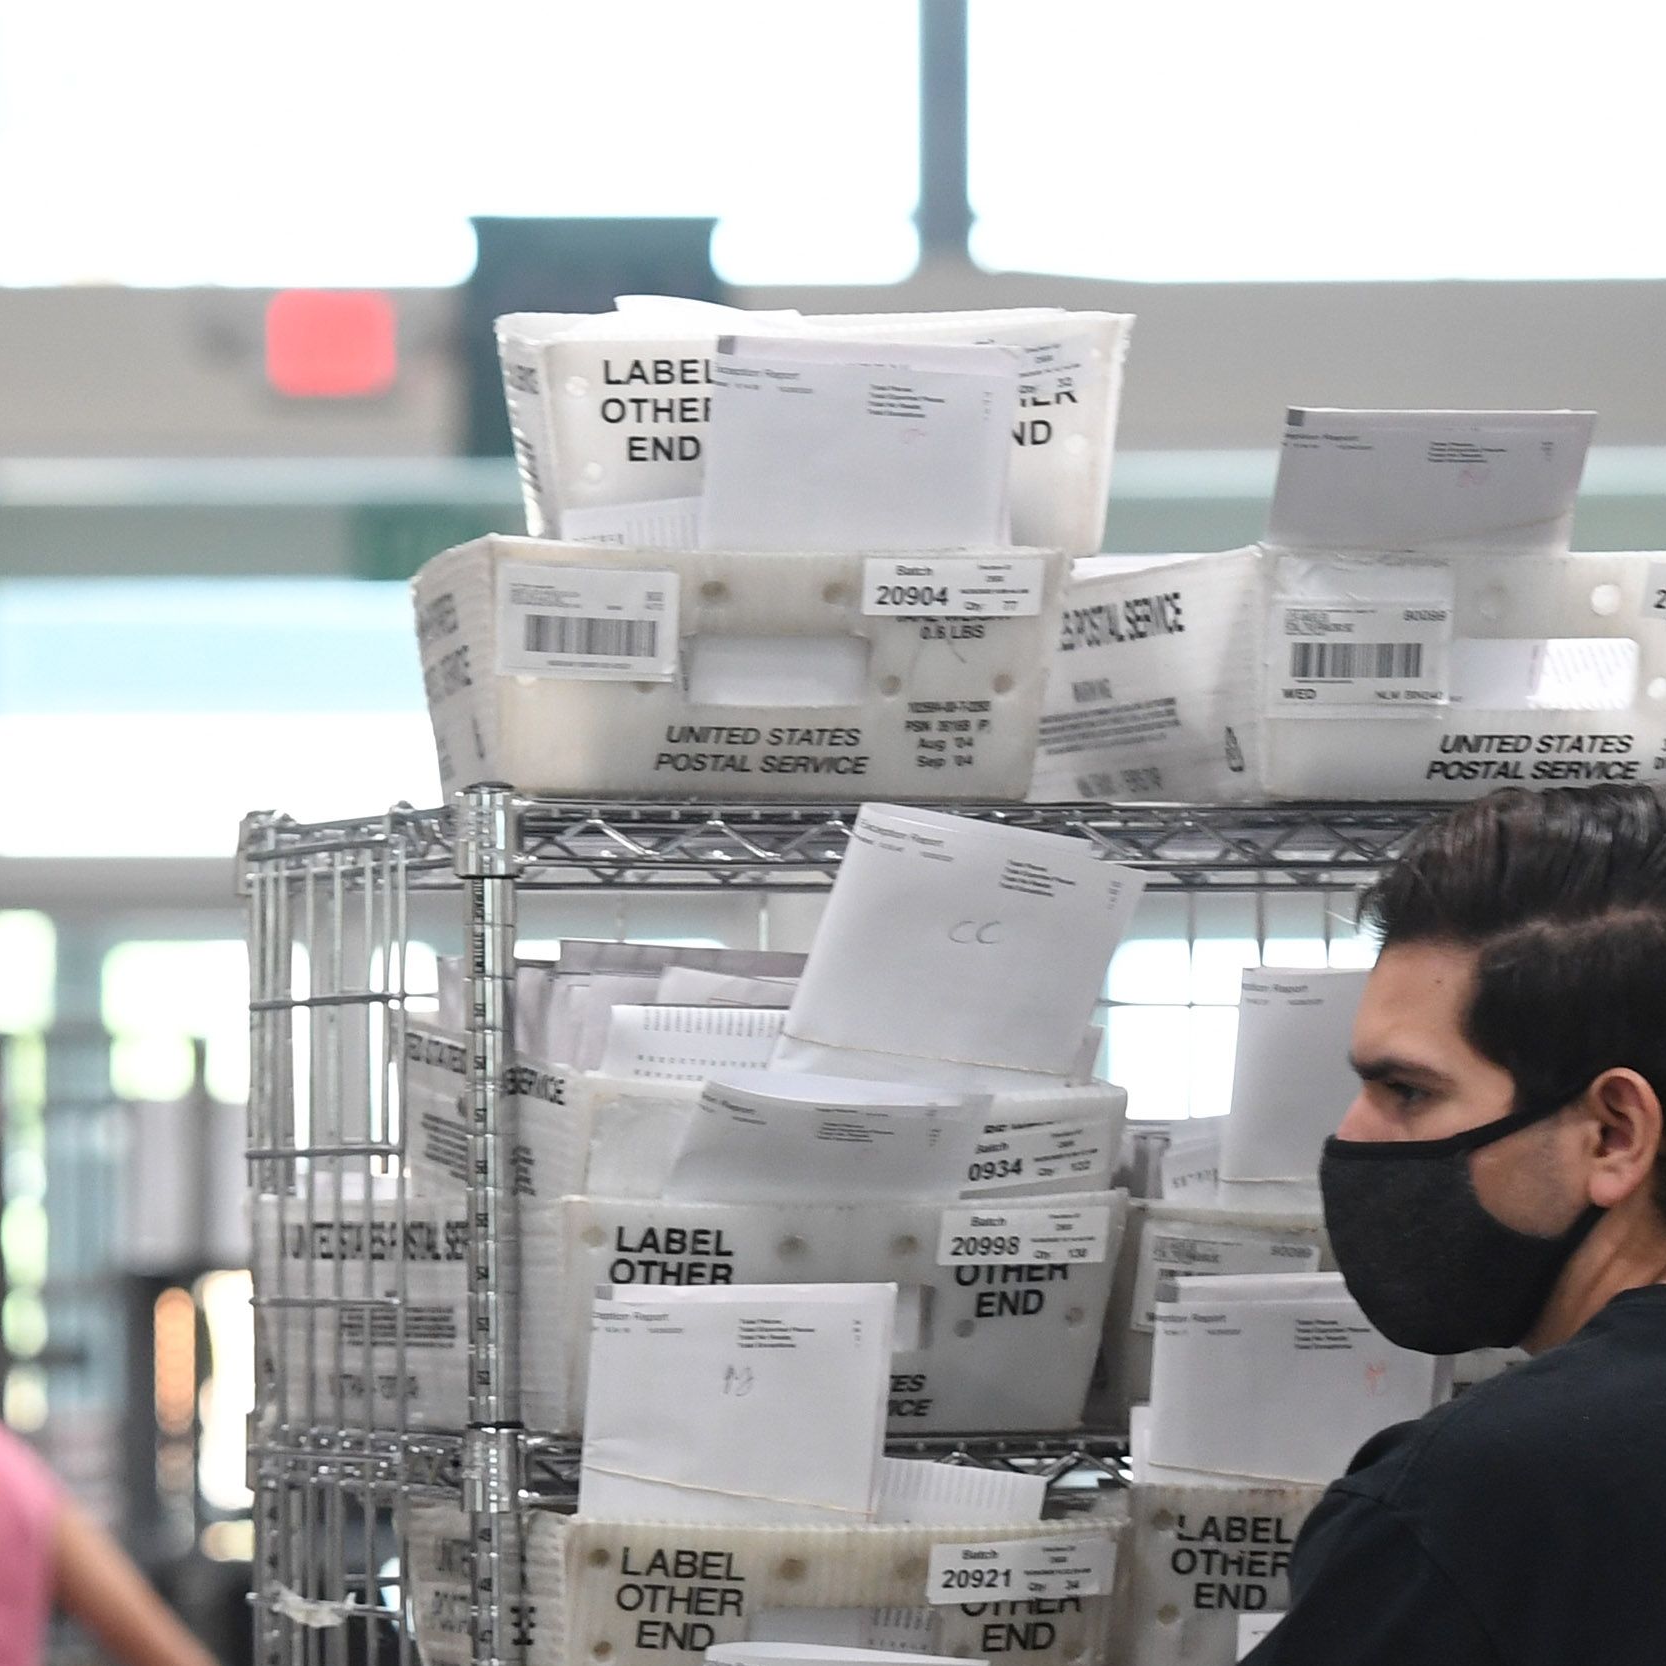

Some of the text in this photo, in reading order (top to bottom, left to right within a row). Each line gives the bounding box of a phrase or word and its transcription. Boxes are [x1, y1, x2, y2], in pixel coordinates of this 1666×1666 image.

[627, 434, 702, 462] END
[895, 564, 933, 576] Batch
[875, 585, 950, 606] 20904
[950, 624, 985, 640] LBS
[1281, 688, 1317, 701] WED
[665, 725, 861, 747] UNITED STATES
[1439, 733, 1634, 754] UNITED STATES
[654, 752, 870, 775] POSTAL SERVICE
[1425, 760, 1640, 781] POSTAL SERVICE
[967, 1157, 1023, 1182] 0934
[969, 1215, 1007, 1227] Batch
[614, 1225, 735, 1257] LABEL
[949, 1235, 1021, 1257] 20998
[608, 1258, 734, 1287] OTHER
[974, 1288, 1044, 1318] END
[1176, 1514, 1294, 1544] LABEL
[620, 1546, 746, 1582] LABEL
[961, 1549, 999, 1561] Batch
[941, 1568, 1012, 1589] 20921
[616, 1583, 744, 1618] OTHER
[1194, 1582, 1268, 1611] END
[634, 1619, 715, 1652] END
[981, 1621, 1057, 1653] END
